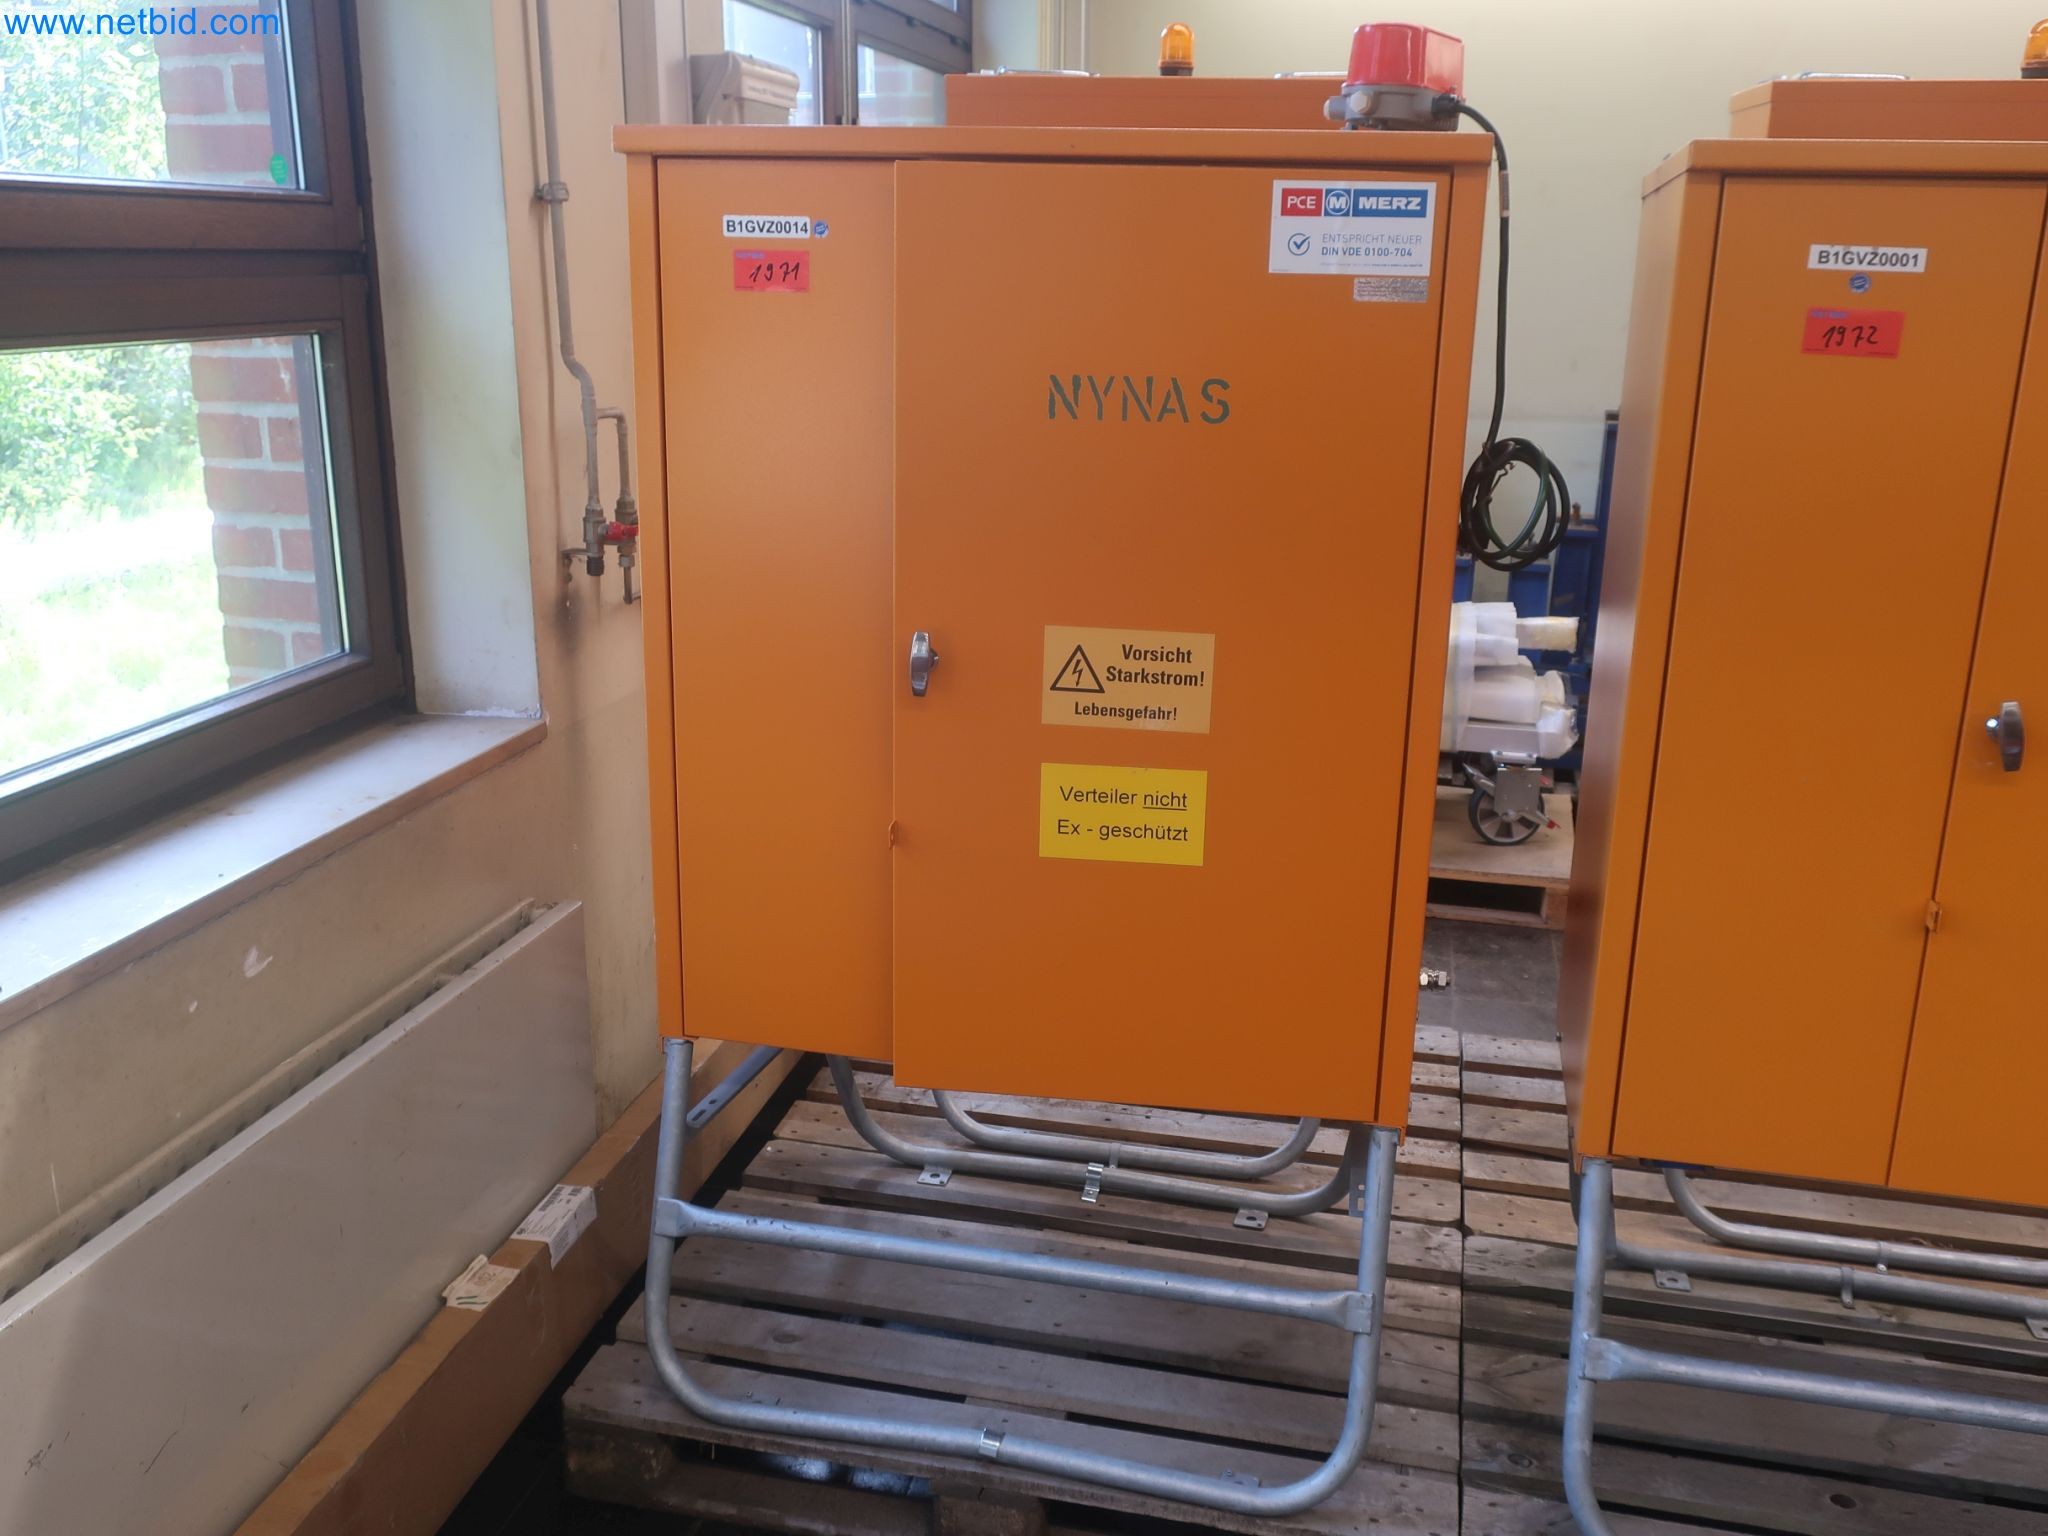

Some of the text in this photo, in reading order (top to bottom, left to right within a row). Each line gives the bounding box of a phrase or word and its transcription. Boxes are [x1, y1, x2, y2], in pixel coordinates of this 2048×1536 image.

[1287, 195, 1317, 209] PCE
[1358, 196, 1421, 210] MERZ
[726, 219, 808, 234] B1GVZ0014
[1322, 233, 1422, 245] ENTSPRICHT NEUER
[1321, 246, 1413, 257] DIN VDE 0100-704
[1817, 249, 1920, 268] B1GVZ0001
[748, 261, 800, 283] 1971
[1822, 325, 1878, 348] 1972
[1048, 374, 1231, 425] NYNAS
[1121, 643, 1193, 664] Vorsicht
[1106, 665, 1205, 687] Starkstrom!
[1074, 701, 1177, 721] Lebensgefahr!
[1059, 785, 1188, 808] Verteiler nicht
[1057, 818, 1081, 836] Ex
[1098, 822, 1189, 842] geschützt
